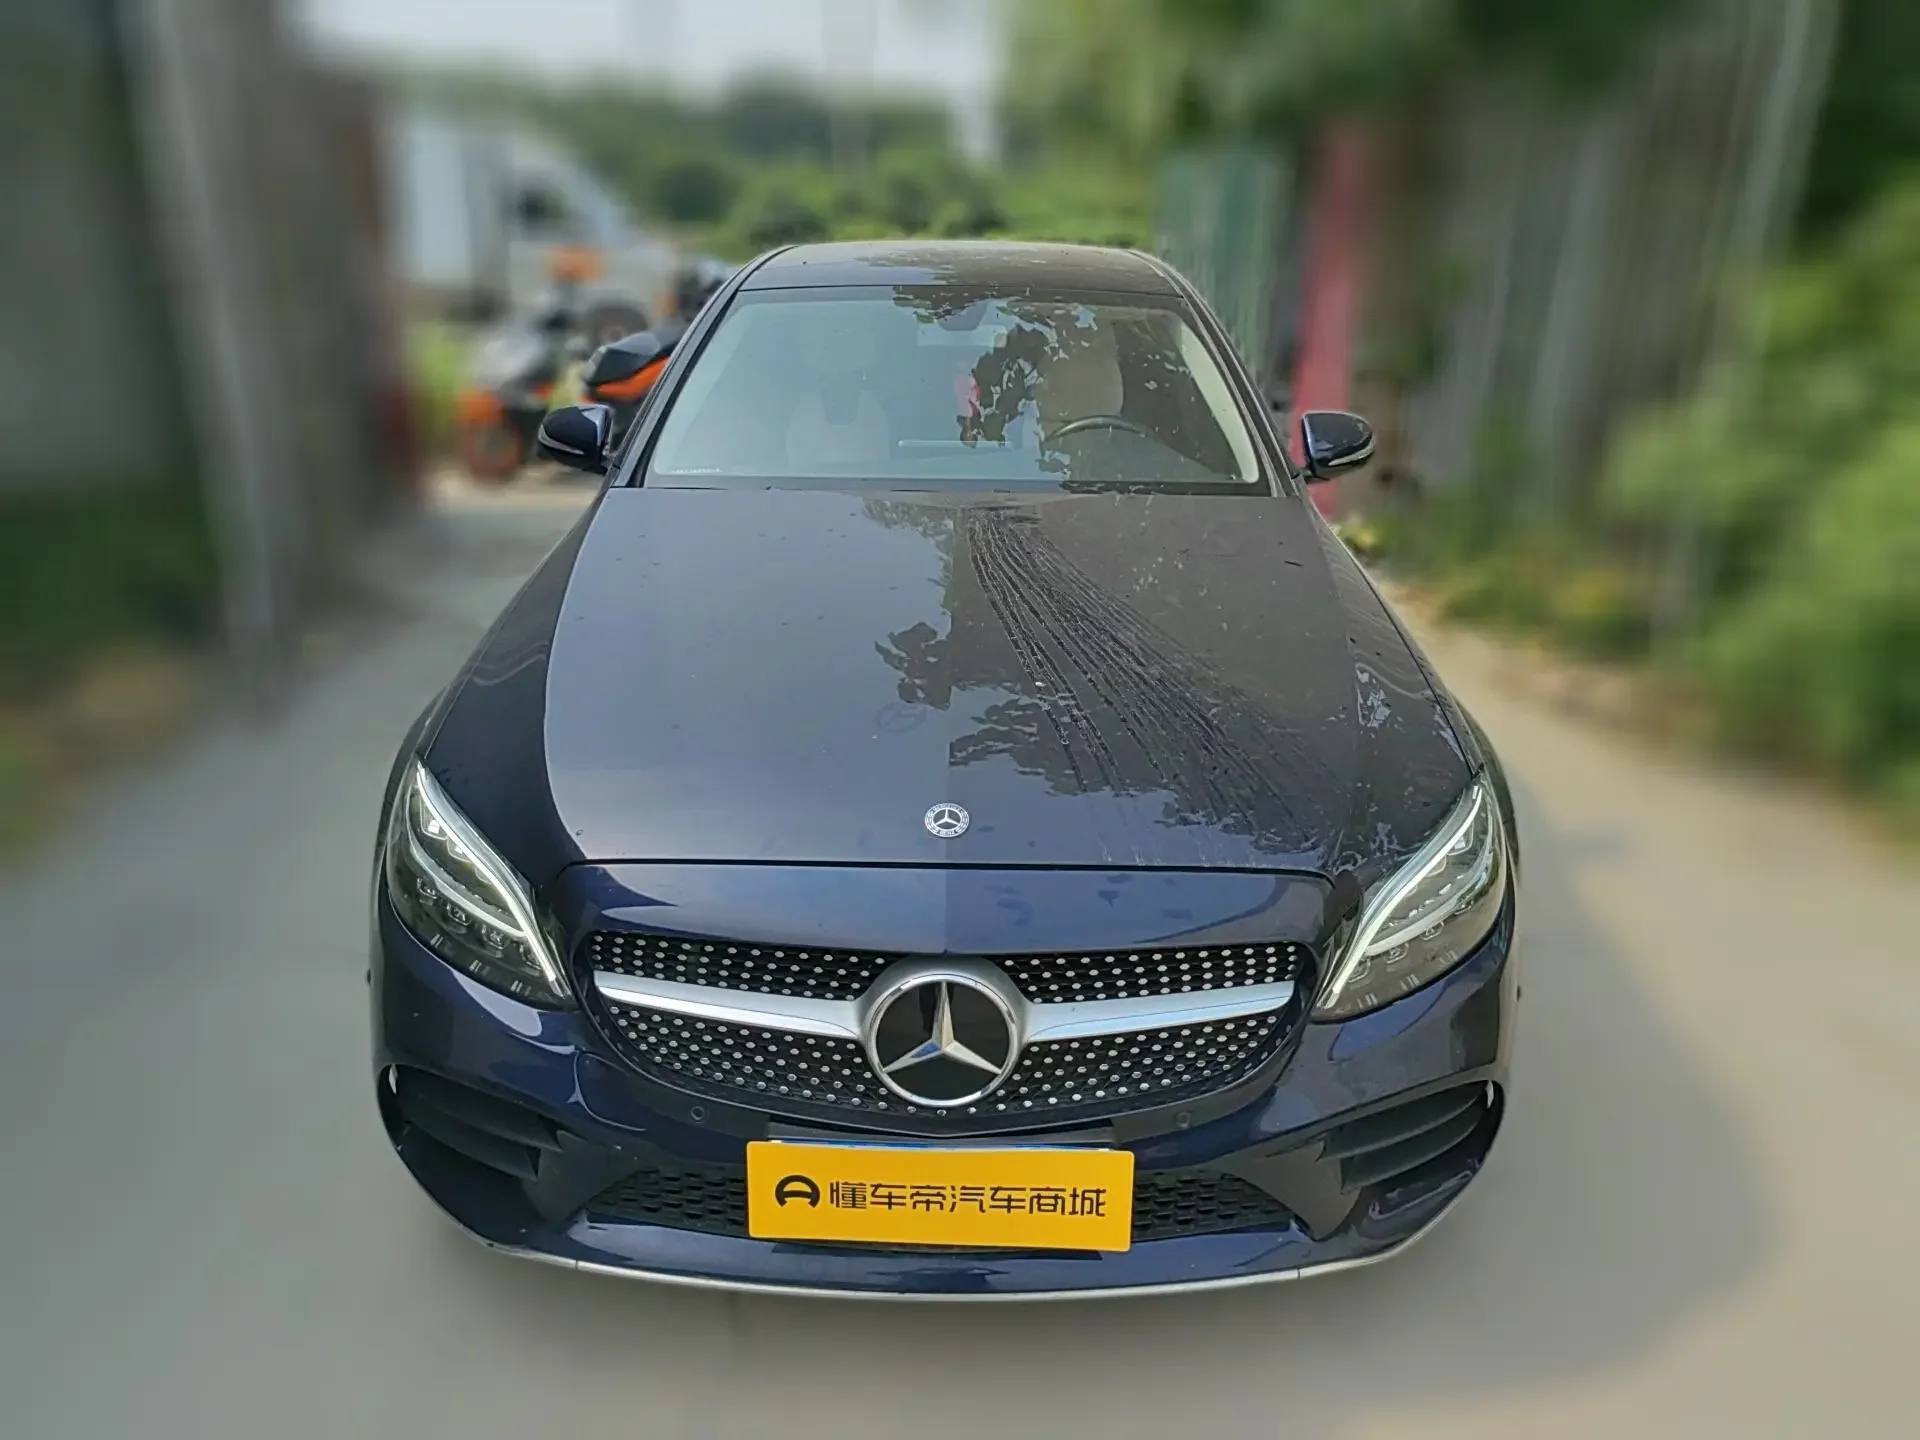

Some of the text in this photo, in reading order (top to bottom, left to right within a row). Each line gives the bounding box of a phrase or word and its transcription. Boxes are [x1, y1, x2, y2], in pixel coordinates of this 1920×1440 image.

[829, 1181, 1106, 1217] 懂车帝汽车商城
